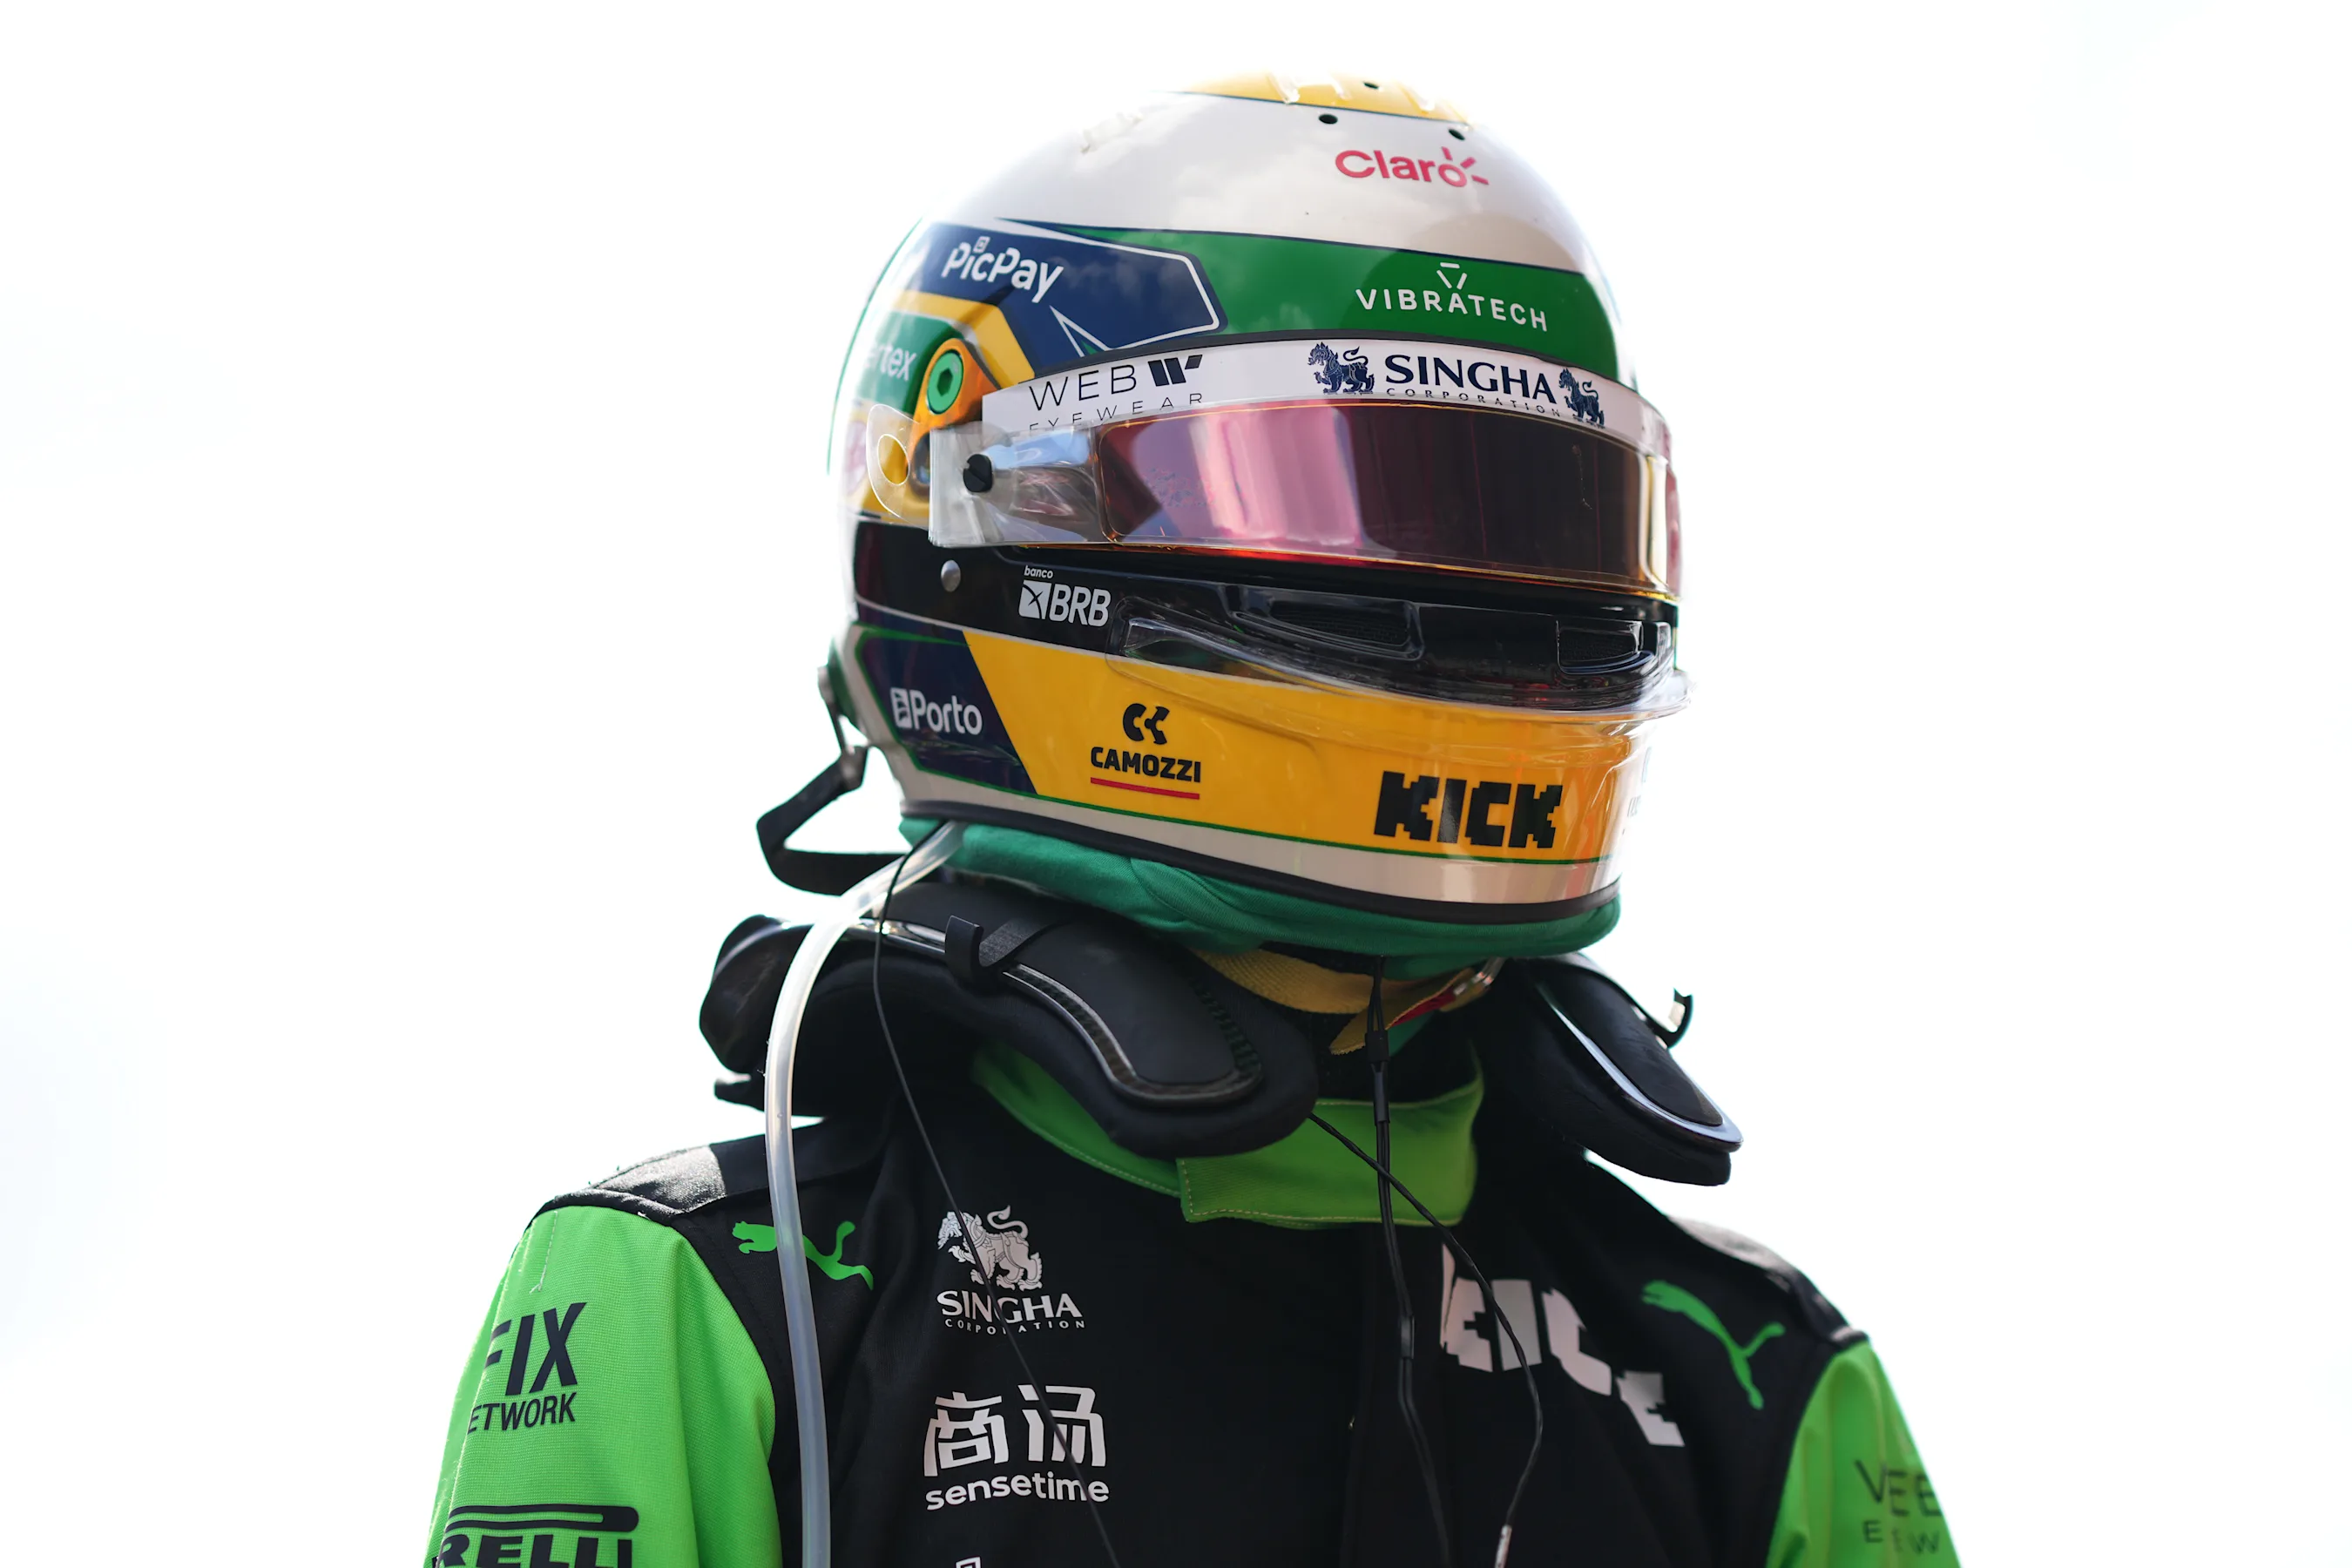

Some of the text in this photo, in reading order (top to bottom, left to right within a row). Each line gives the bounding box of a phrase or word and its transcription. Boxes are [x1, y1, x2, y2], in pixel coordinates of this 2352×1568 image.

[1335, 149, 1468, 188] Claro
[941, 236, 1064, 303] PicPay
[1355, 288, 1548, 332] VIBRATECH
[1029, 364, 1137, 411] WEB
[1384, 354, 1558, 405] SINGHA
[1386, 388, 1561, 417] CORPORATION
[1024, 564, 1054, 579] banco
[1049, 583, 1112, 627] BRB
[909, 688, 983, 735] Porto
[1090, 746, 1201, 783] CAMOZZI
[1374, 770, 1563, 849] KICK
[936, 1290, 1083, 1324] SINGHA
[467, 1392, 577, 1435] ETWORK
[923, 1384, 1106, 1477] 商汤
[925, 1471, 1110, 1511] sensetime
